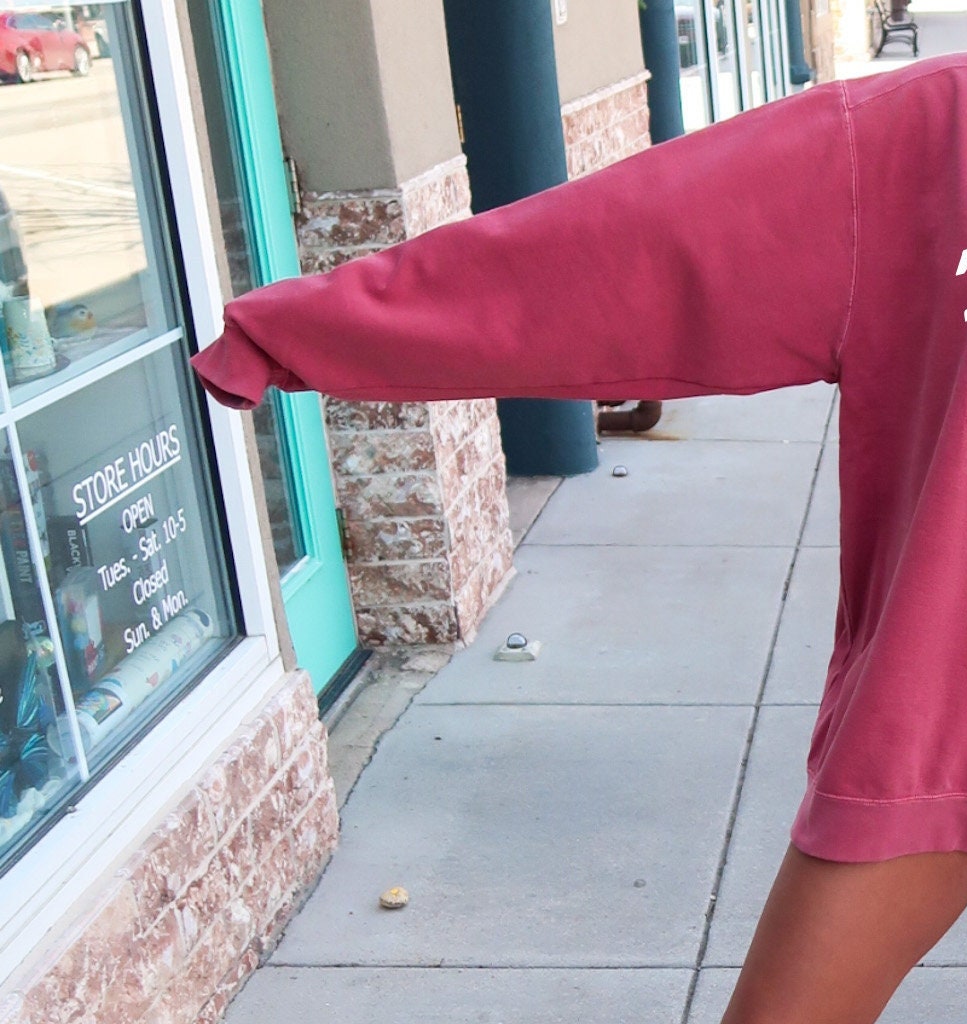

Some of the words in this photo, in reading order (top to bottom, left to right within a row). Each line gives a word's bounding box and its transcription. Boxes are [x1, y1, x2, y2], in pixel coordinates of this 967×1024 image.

[72, 456, 129, 519] STORE
[129, 423, 181, 482] HOURS
[121, 493, 155, 534] OPEN
[97, 557, 131, 591] Tues.
[138, 534, 162, 559] Sat.
[162, 507, 187, 544] 10-5
[132, 559, 169, 605] Closed
[123, 623, 150, 654] Sun.
[150, 608, 163, 630] &
[161, 589, 189, 623] Mon.
